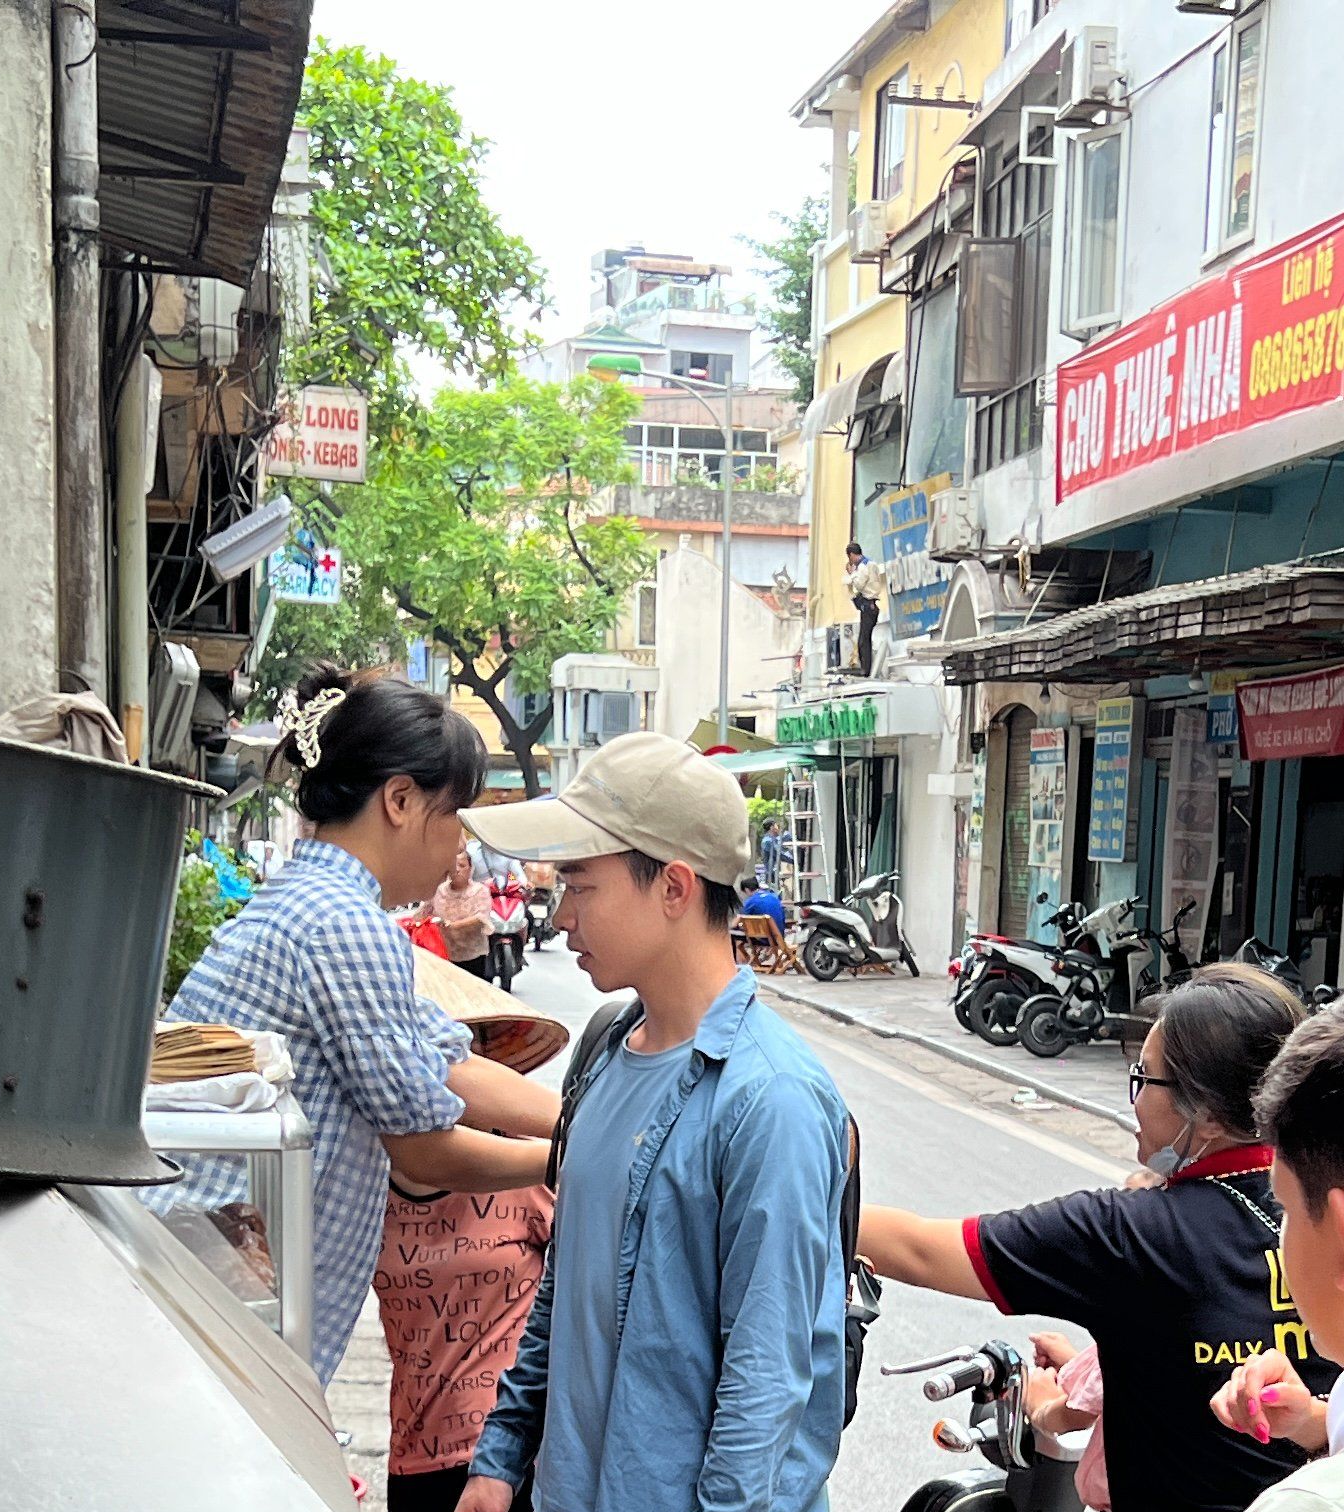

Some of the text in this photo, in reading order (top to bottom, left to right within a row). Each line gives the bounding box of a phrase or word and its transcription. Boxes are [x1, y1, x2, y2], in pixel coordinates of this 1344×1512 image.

[1282, 237, 1334, 305] Liên hệ
[305, 405, 359, 431] LONG
[1062, 372, 1107, 481] CHO
[1112, 313, 1178, 460] THUÊ
[314, 440, 358, 468] KEBAB
